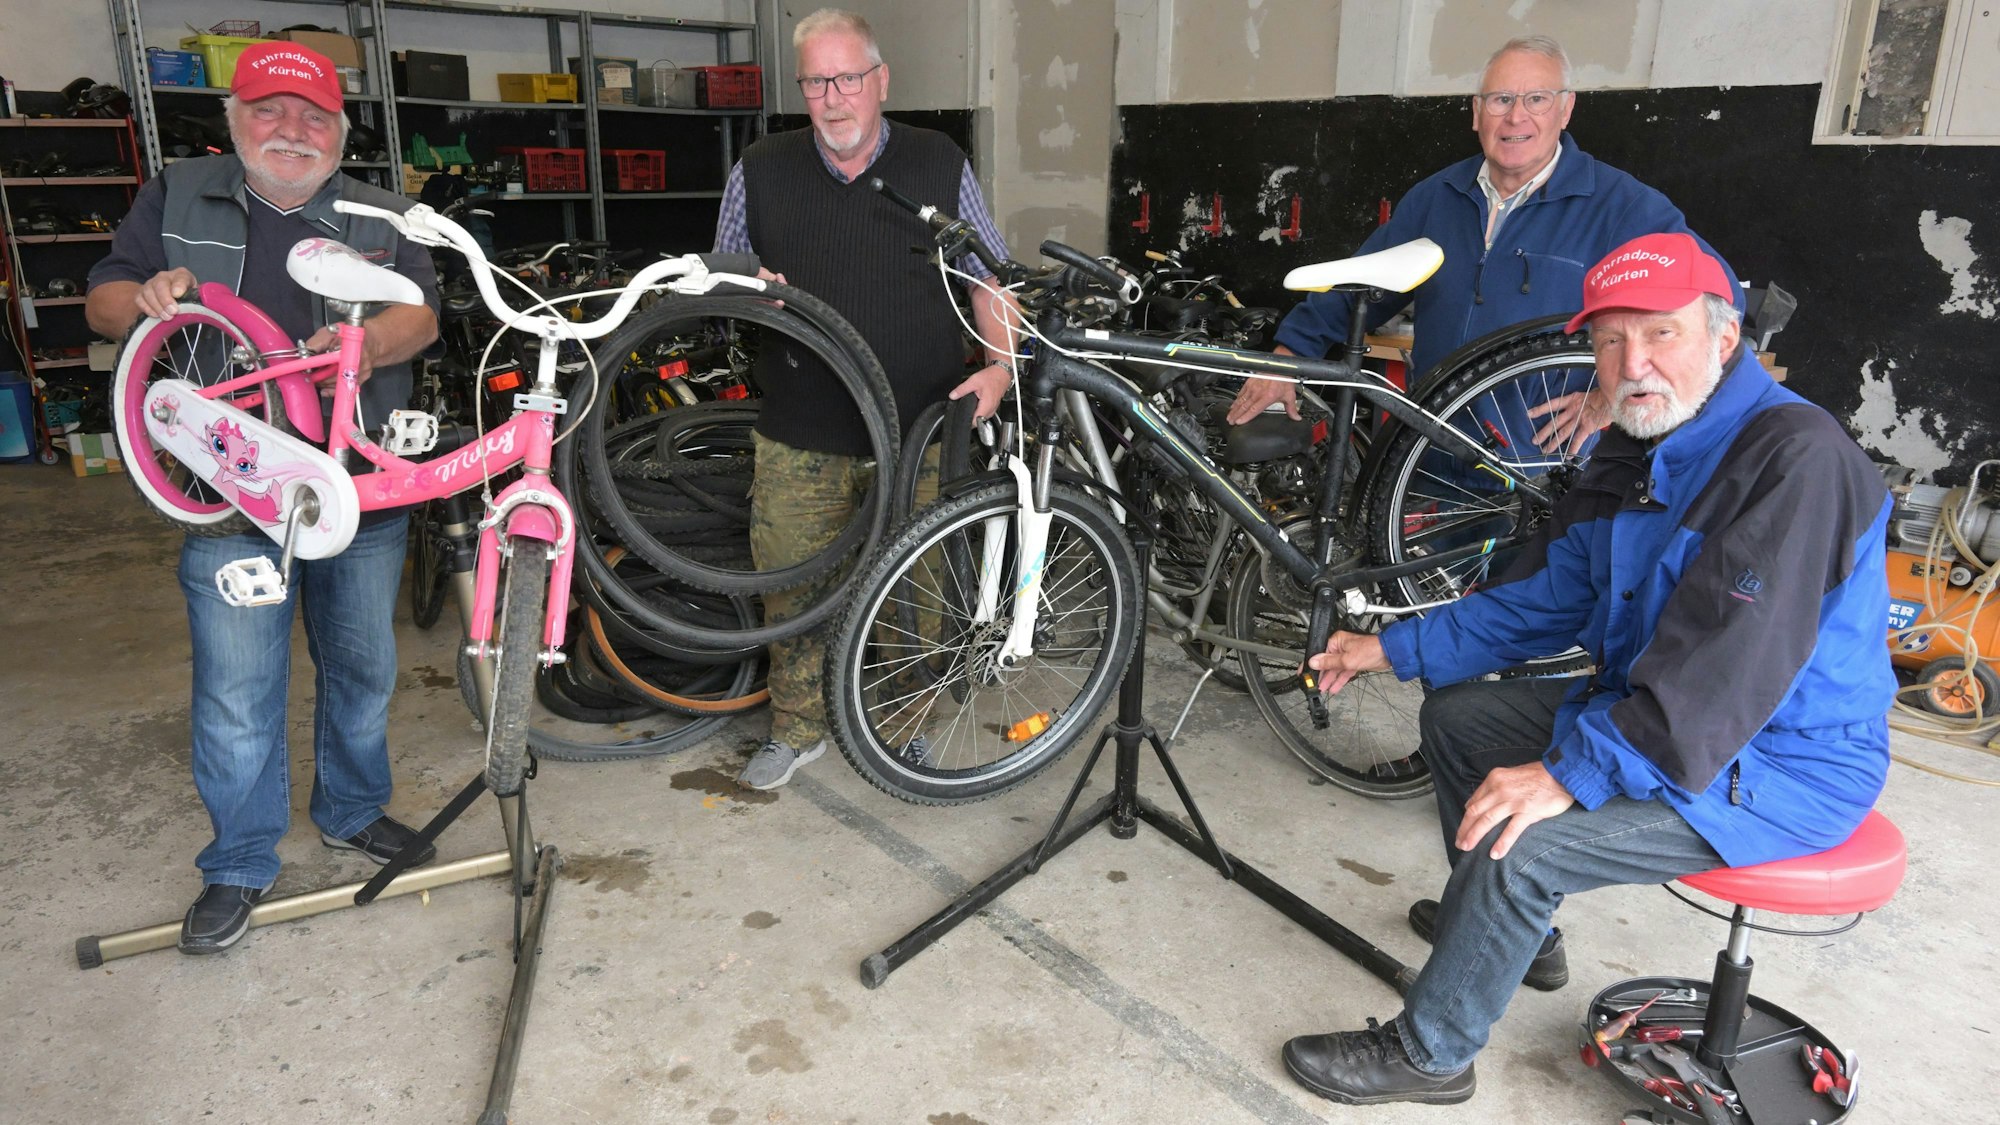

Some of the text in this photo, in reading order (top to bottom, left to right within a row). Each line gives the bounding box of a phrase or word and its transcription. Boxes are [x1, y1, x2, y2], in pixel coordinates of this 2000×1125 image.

[252, 52, 324, 78] Fahrradpool
[268, 66, 312, 81] Kürten
[1591, 249, 1676, 287] Fahrradpool
[1601, 268, 1649, 290] Kürten
